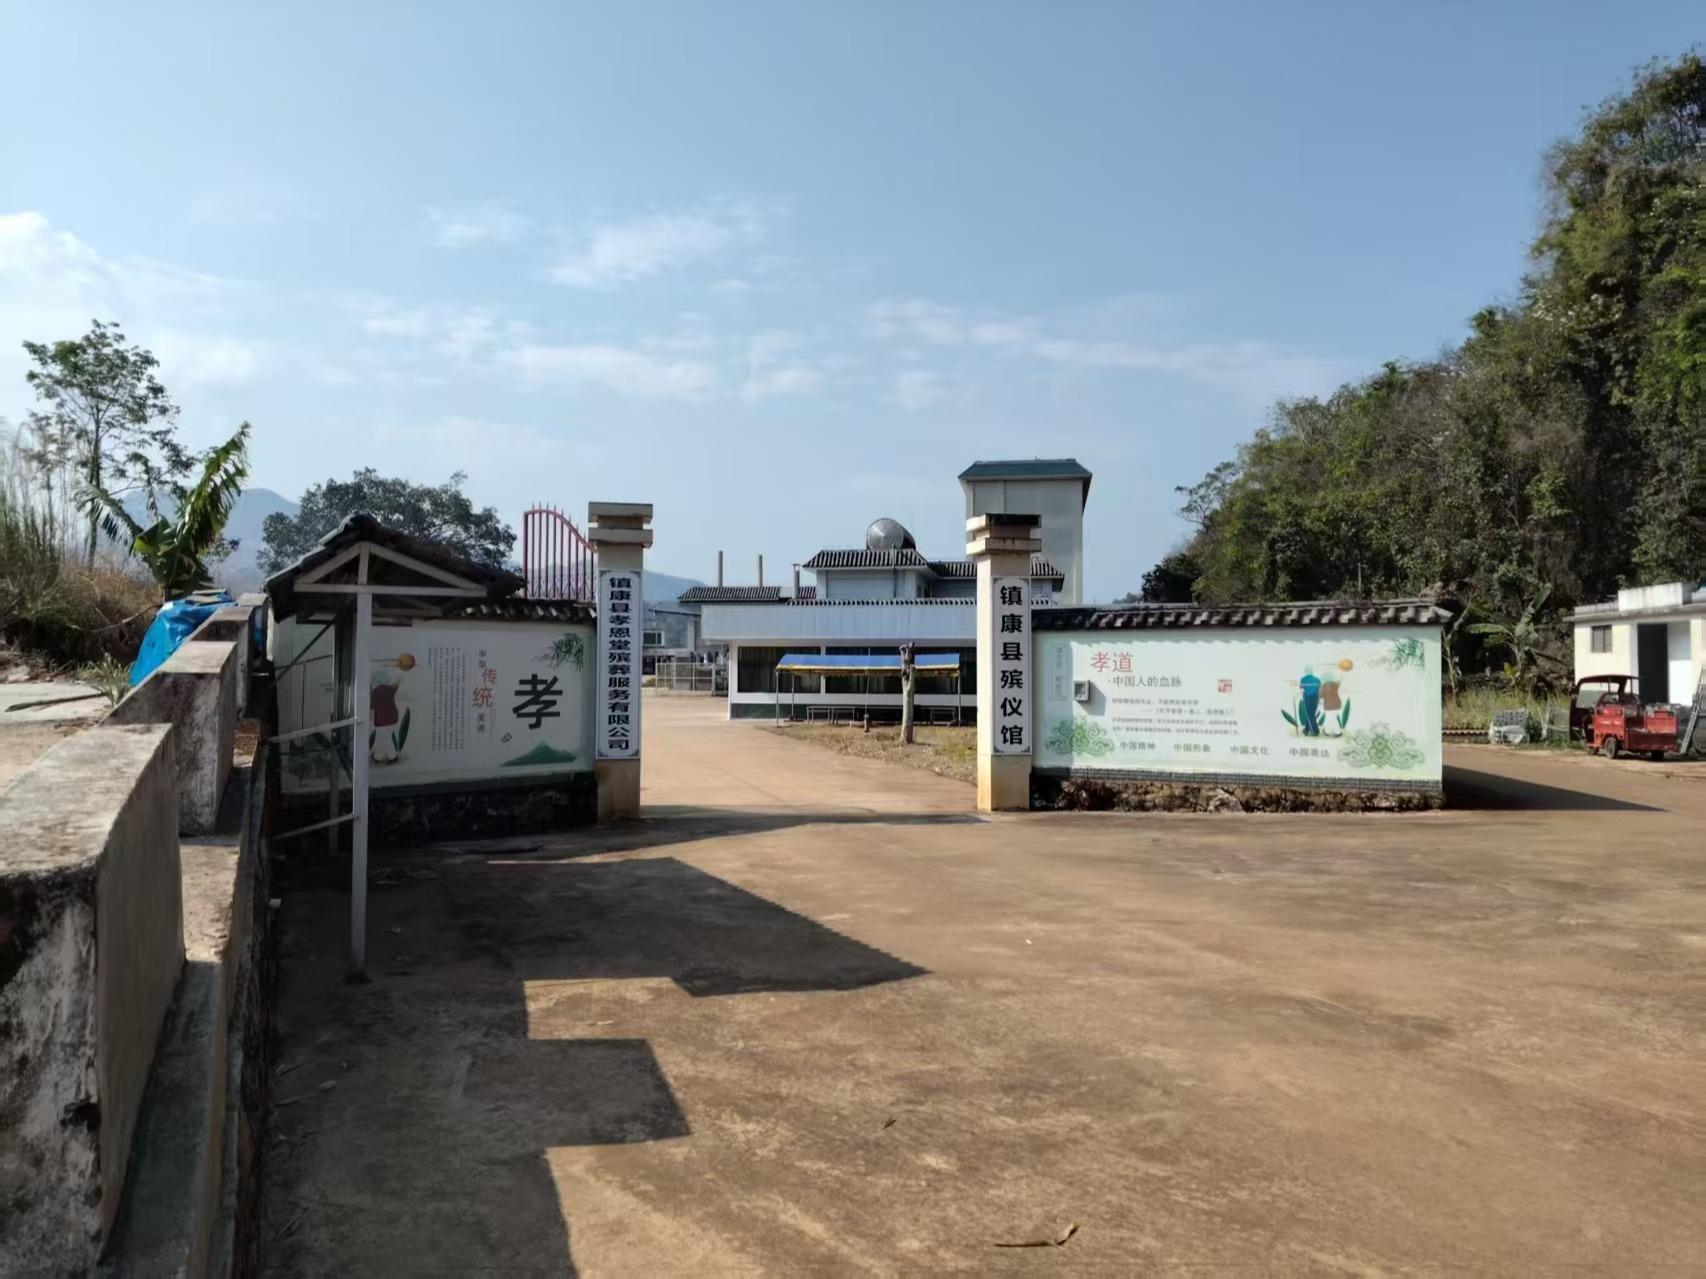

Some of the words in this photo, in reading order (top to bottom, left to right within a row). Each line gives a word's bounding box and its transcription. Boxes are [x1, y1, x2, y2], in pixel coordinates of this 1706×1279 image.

[608, 577, 631, 750] 镇康县孝恩堂殡葬服务有限公司
[1000, 585, 1023, 745] 镇康县殡仪馆
[1091, 651, 1133, 673] 孝道
[512, 673, 563, 730] 孝
[1230, 745, 1269, 755] 中国文化
